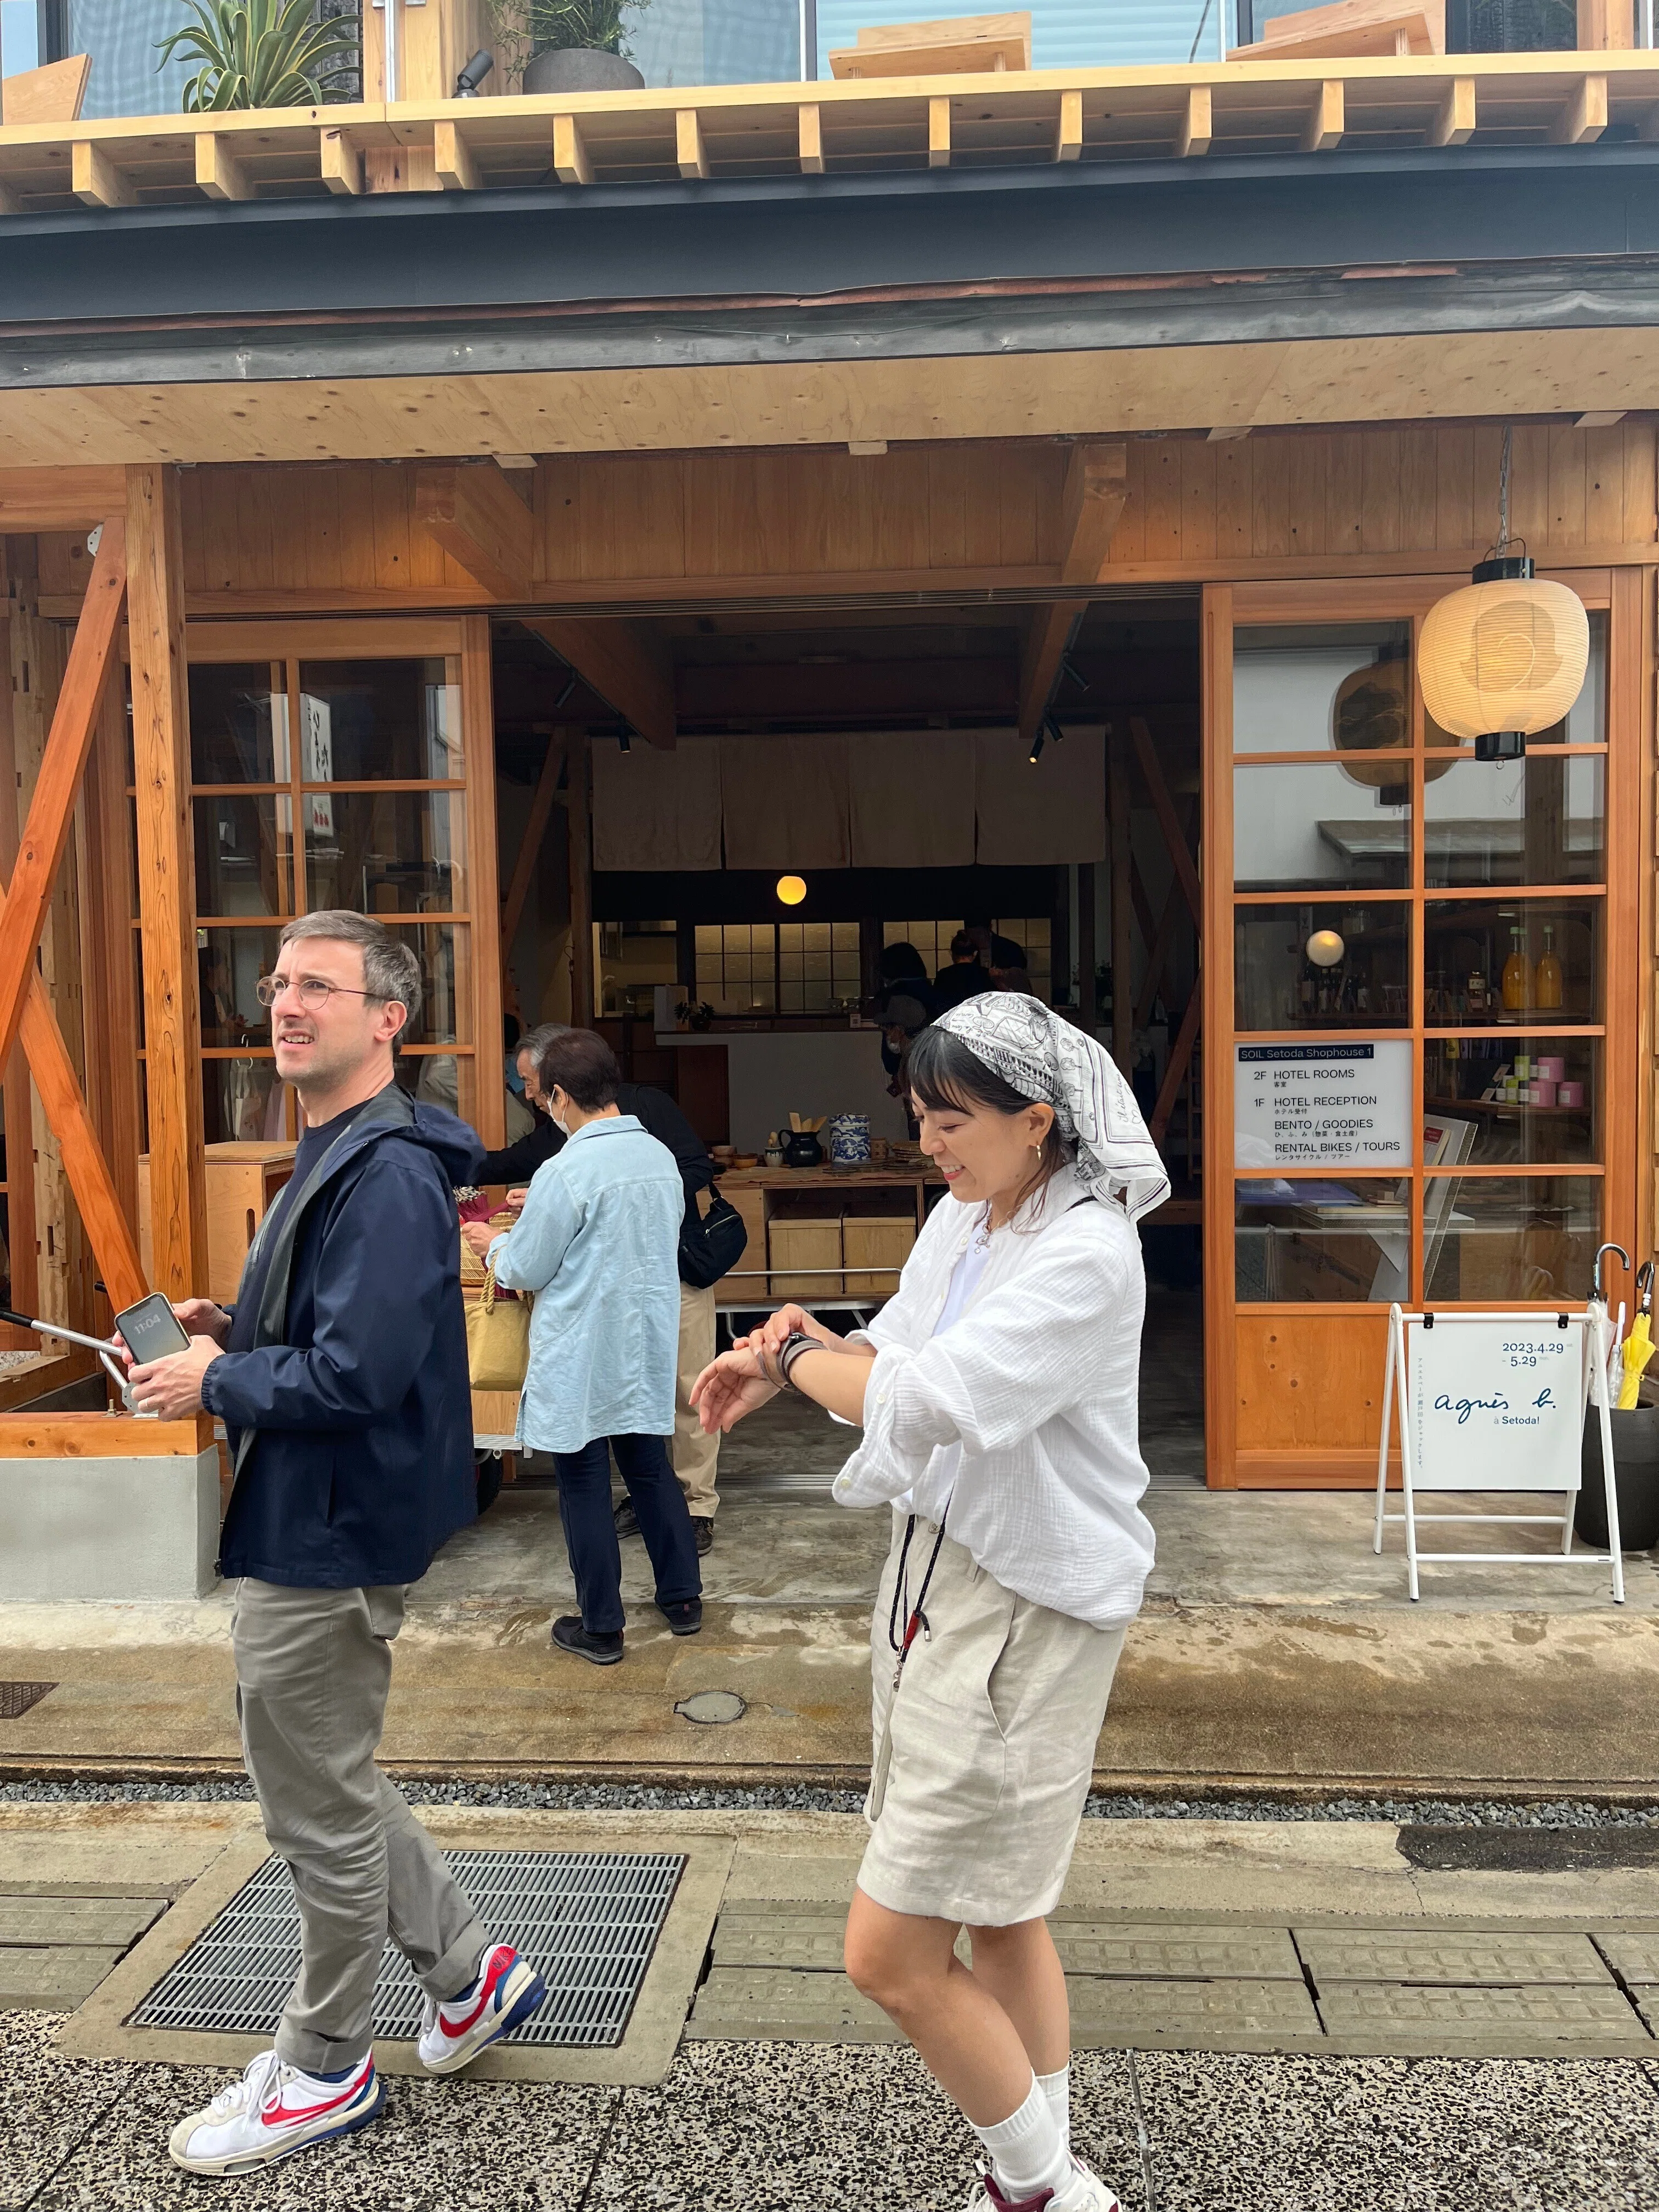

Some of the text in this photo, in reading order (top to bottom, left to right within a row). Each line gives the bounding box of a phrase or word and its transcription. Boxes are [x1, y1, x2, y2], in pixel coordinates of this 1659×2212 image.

[1241, 1047, 1372, 1059] SOIL Setoda Shophouse 1
[1254, 1069, 1355, 1080] 2F HOTEL ROOMS
[1254, 1096, 1376, 1107] 1F HOTEL RECEPTION
[1274, 1119, 1373, 1131] BENTO / GOODIES
[1275, 1142, 1400, 1153] RENTAL BIKES / TOURS
[135, 1313, 161, 1334] 11:04
[1502, 1342, 1564, 1354] 2023.4.29
[1510, 1356, 1537, 1367] 5.29
[1434, 1387, 1556, 1424] agnès b.
[1493, 1416, 1539, 1425] à Setoda!
